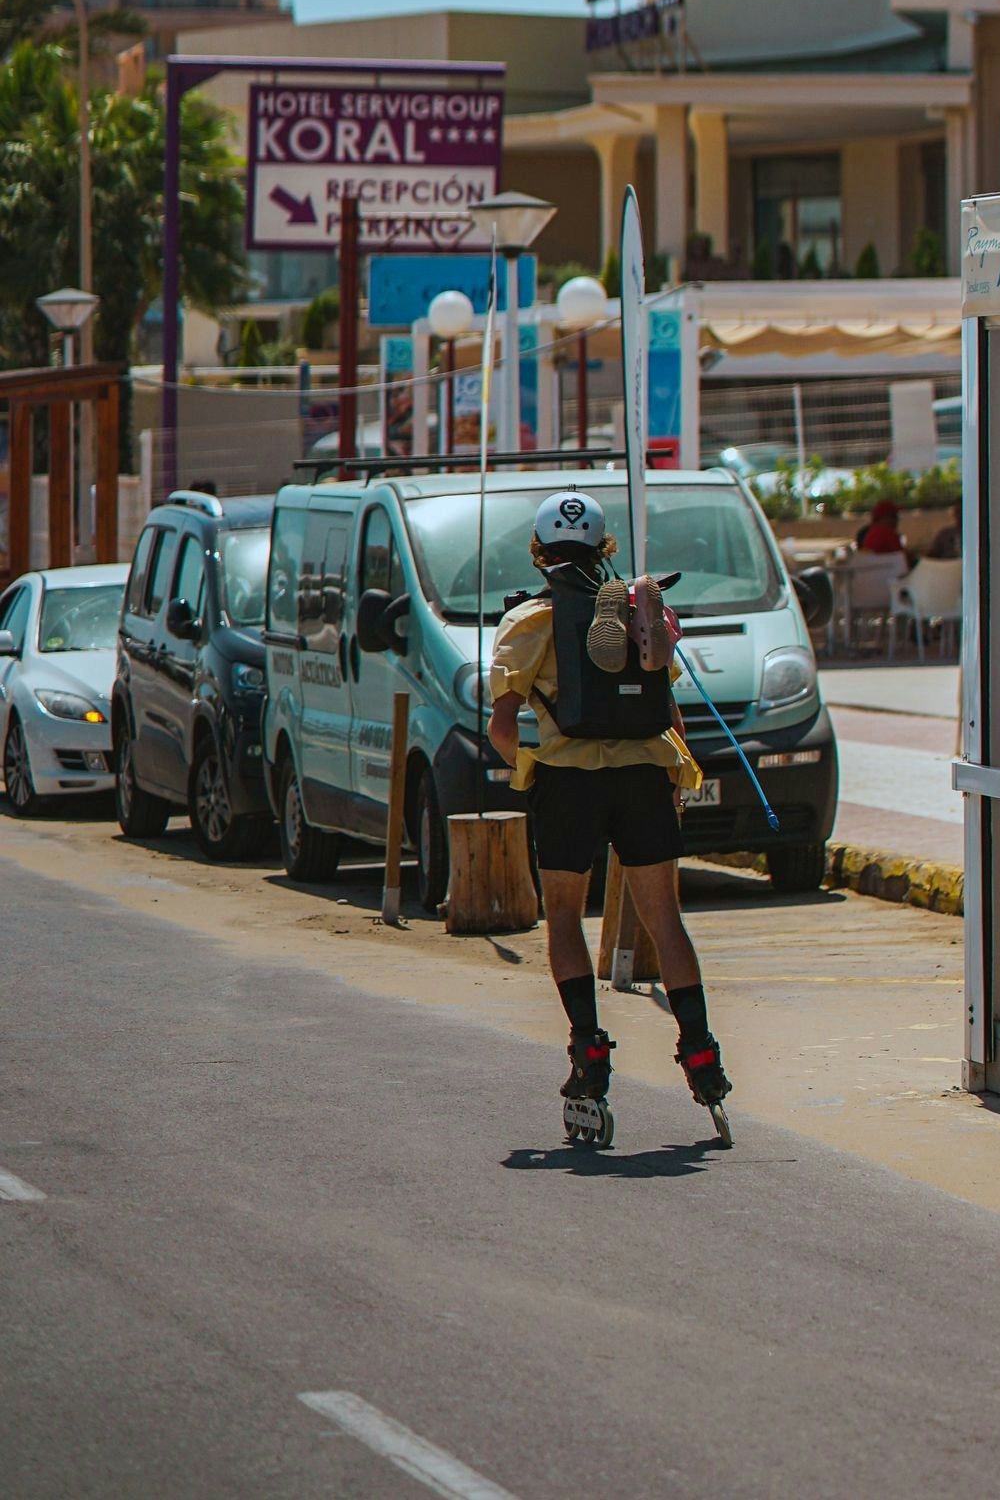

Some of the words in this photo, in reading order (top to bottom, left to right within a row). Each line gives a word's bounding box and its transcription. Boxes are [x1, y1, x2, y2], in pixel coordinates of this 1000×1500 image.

[258, 92, 334, 116] HOTEL
[341, 94, 499, 121] SERVIGROUP
[258, 118, 426, 162] KORAL
[326, 175, 485, 205] RECEPCIÓN
[325, 211, 460, 238] PRKING
